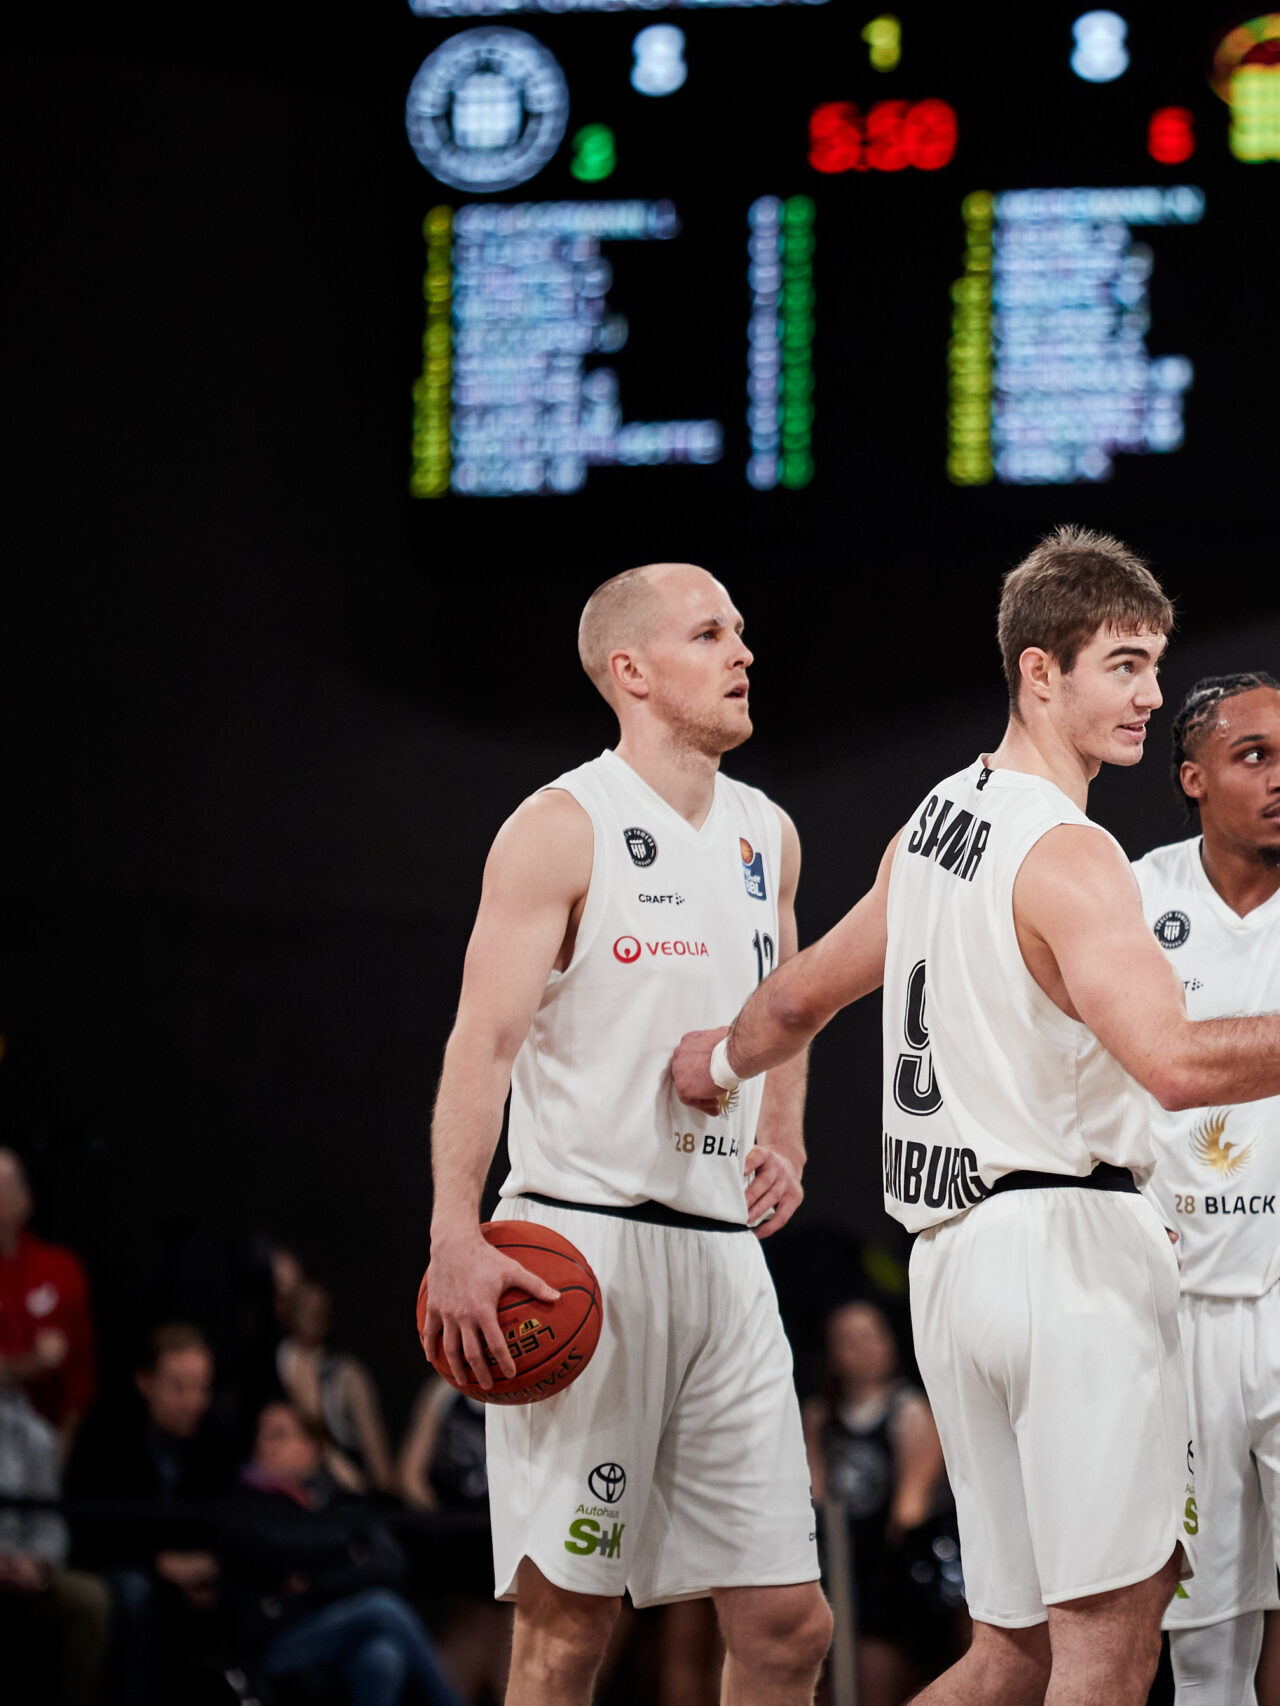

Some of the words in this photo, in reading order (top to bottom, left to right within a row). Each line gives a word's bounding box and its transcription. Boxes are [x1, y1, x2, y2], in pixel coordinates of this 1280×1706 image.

[638, 893, 674, 904] CRAFT
[645, 939, 709, 957] VEOLIA
[893, 959, 943, 1117] 9
[702, 1135, 739, 1157] BLA
[1175, 1194, 1196, 1214] 28
[1205, 1195, 1276, 1215] BLACK
[575, 1504, 620, 1519] Autohau
[564, 1518, 626, 1559] S+K
